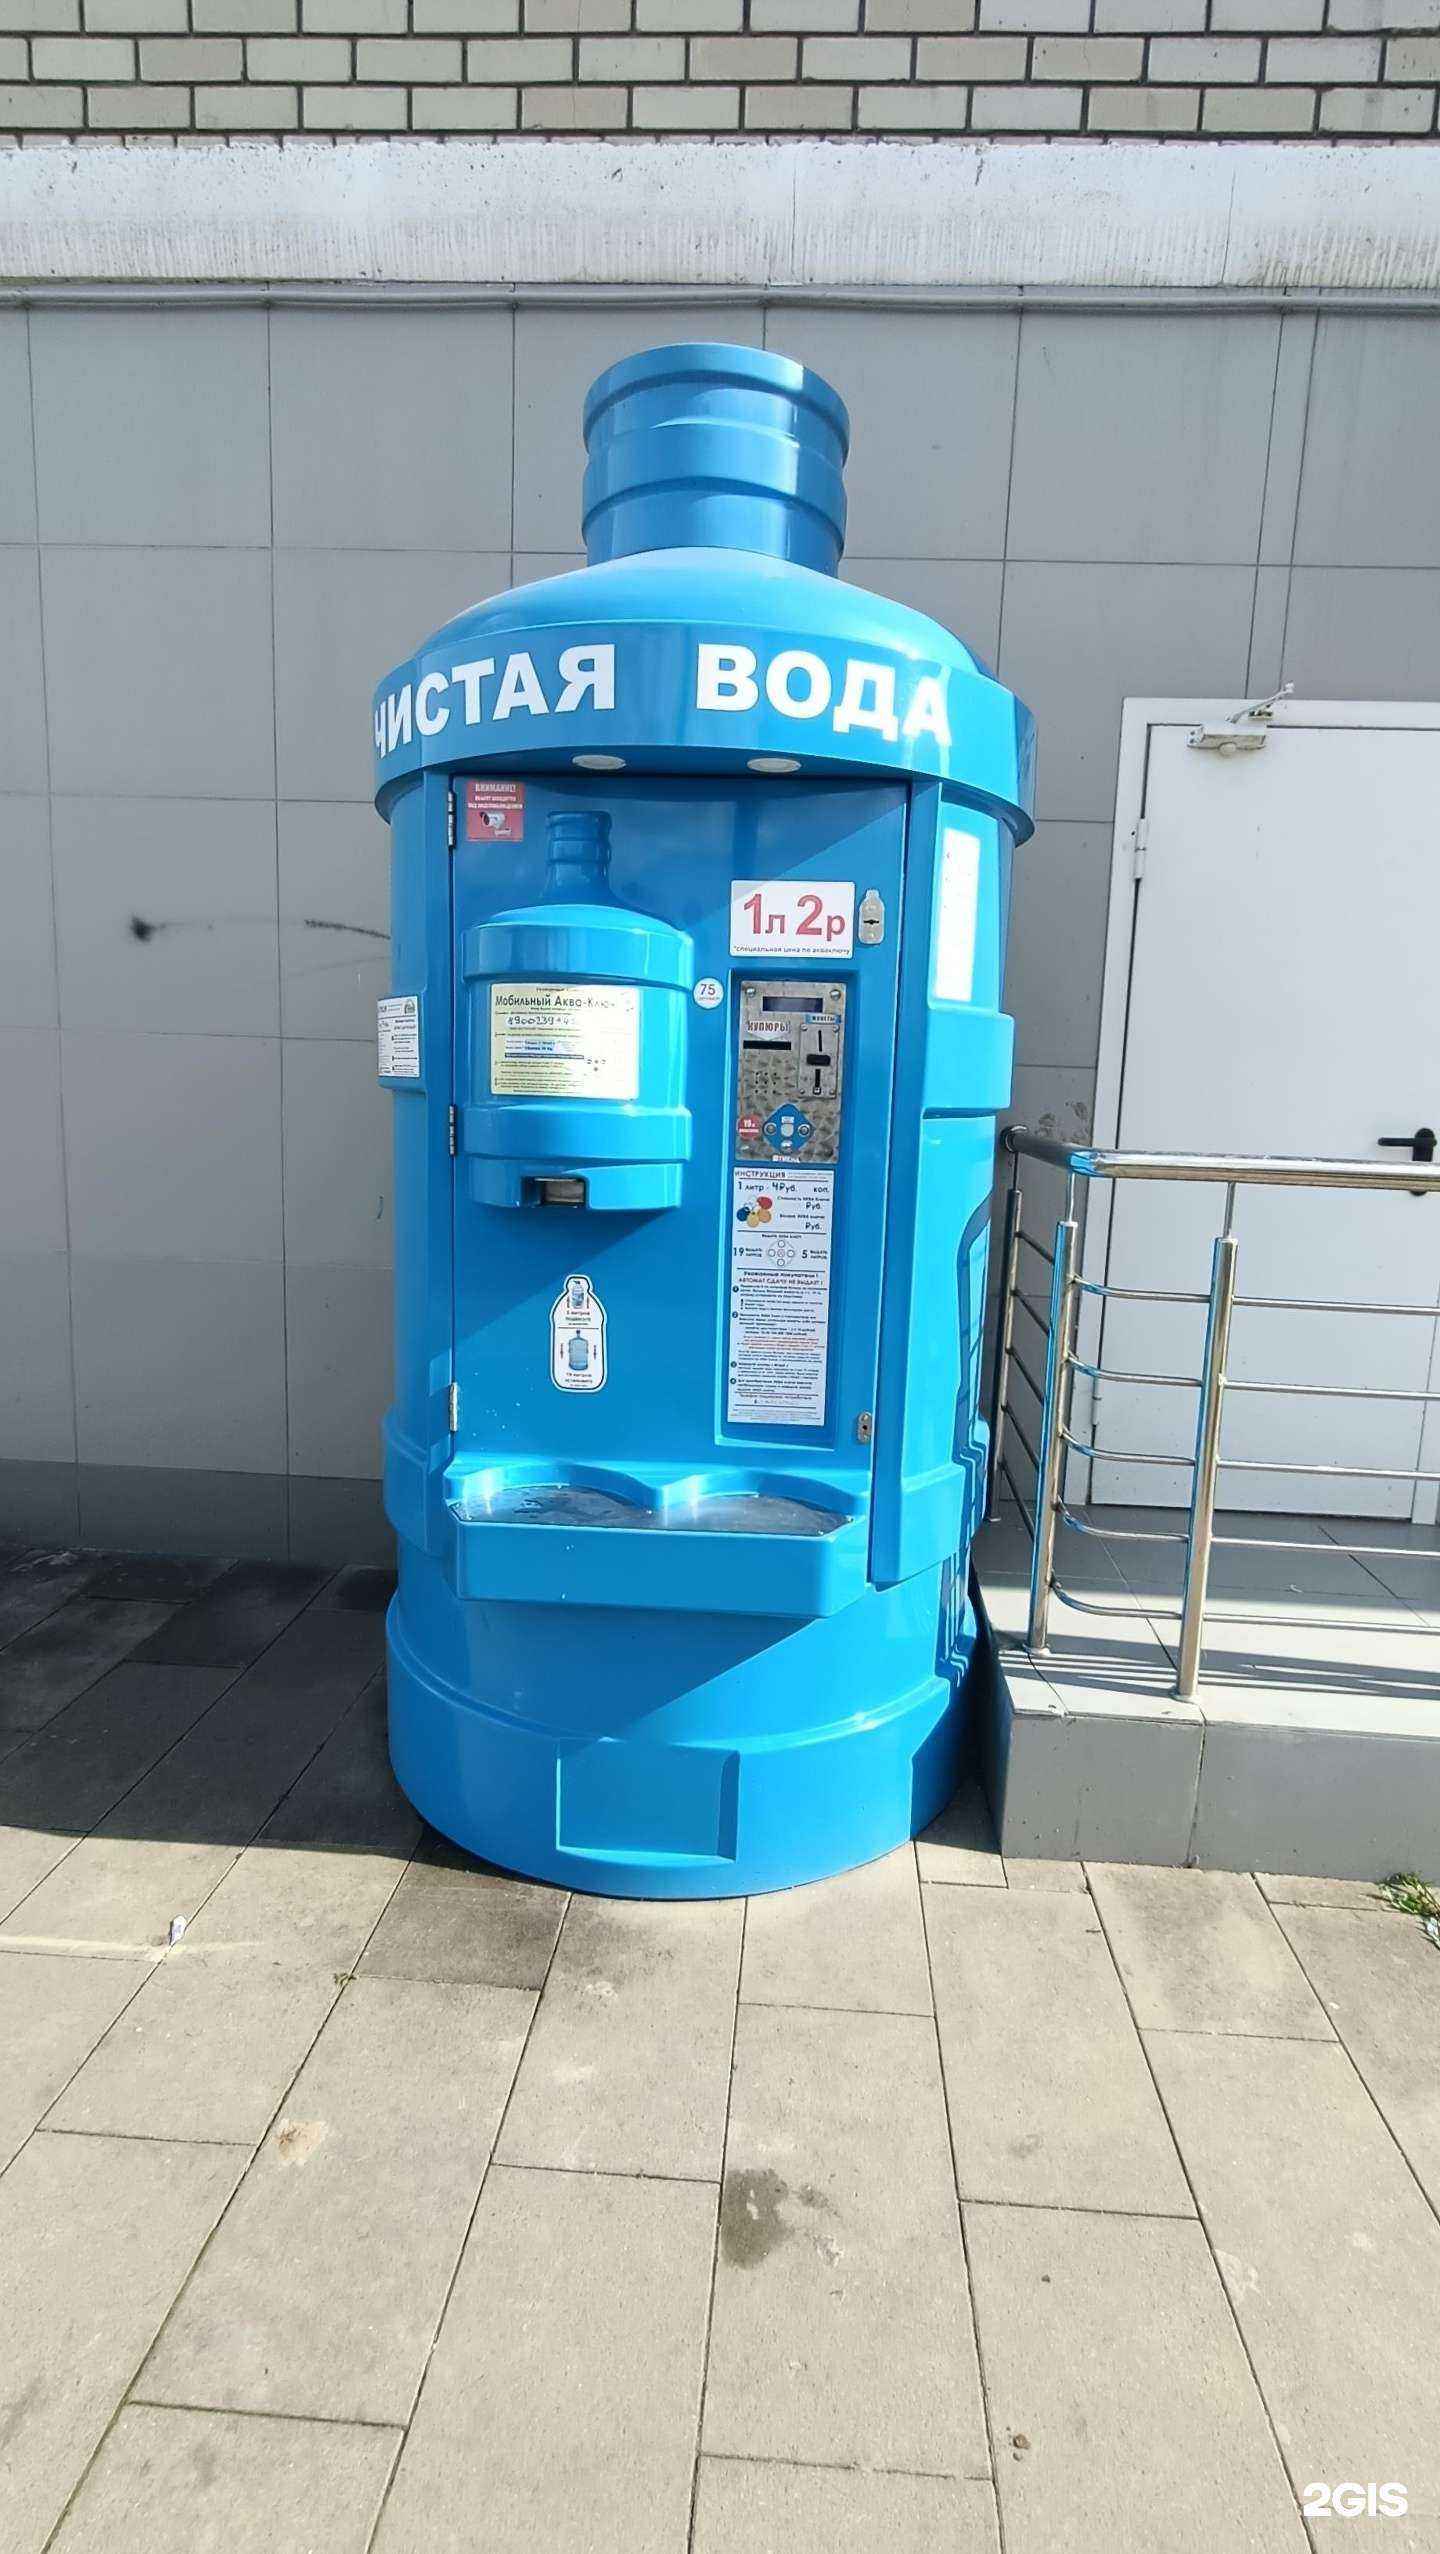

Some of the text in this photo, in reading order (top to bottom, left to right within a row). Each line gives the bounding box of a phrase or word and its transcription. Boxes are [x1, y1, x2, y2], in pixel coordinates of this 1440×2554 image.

[374, 643, 953, 759] ЧИСТАЯ ВОДА
[743, 893, 847, 942] 1л 2р
[700, 983, 716, 996] 75
[495, 993, 551, 1007] Мобильный
[747, 1021, 791, 1033] КУПЮРЫ
[734, 1169, 786, 1179] ИНСТРУКЦИЯ
[745, 1184, 765, 1192] литр
[733, 1246, 745, 1257] 19
[801, 1249, 808, 1259] 5
